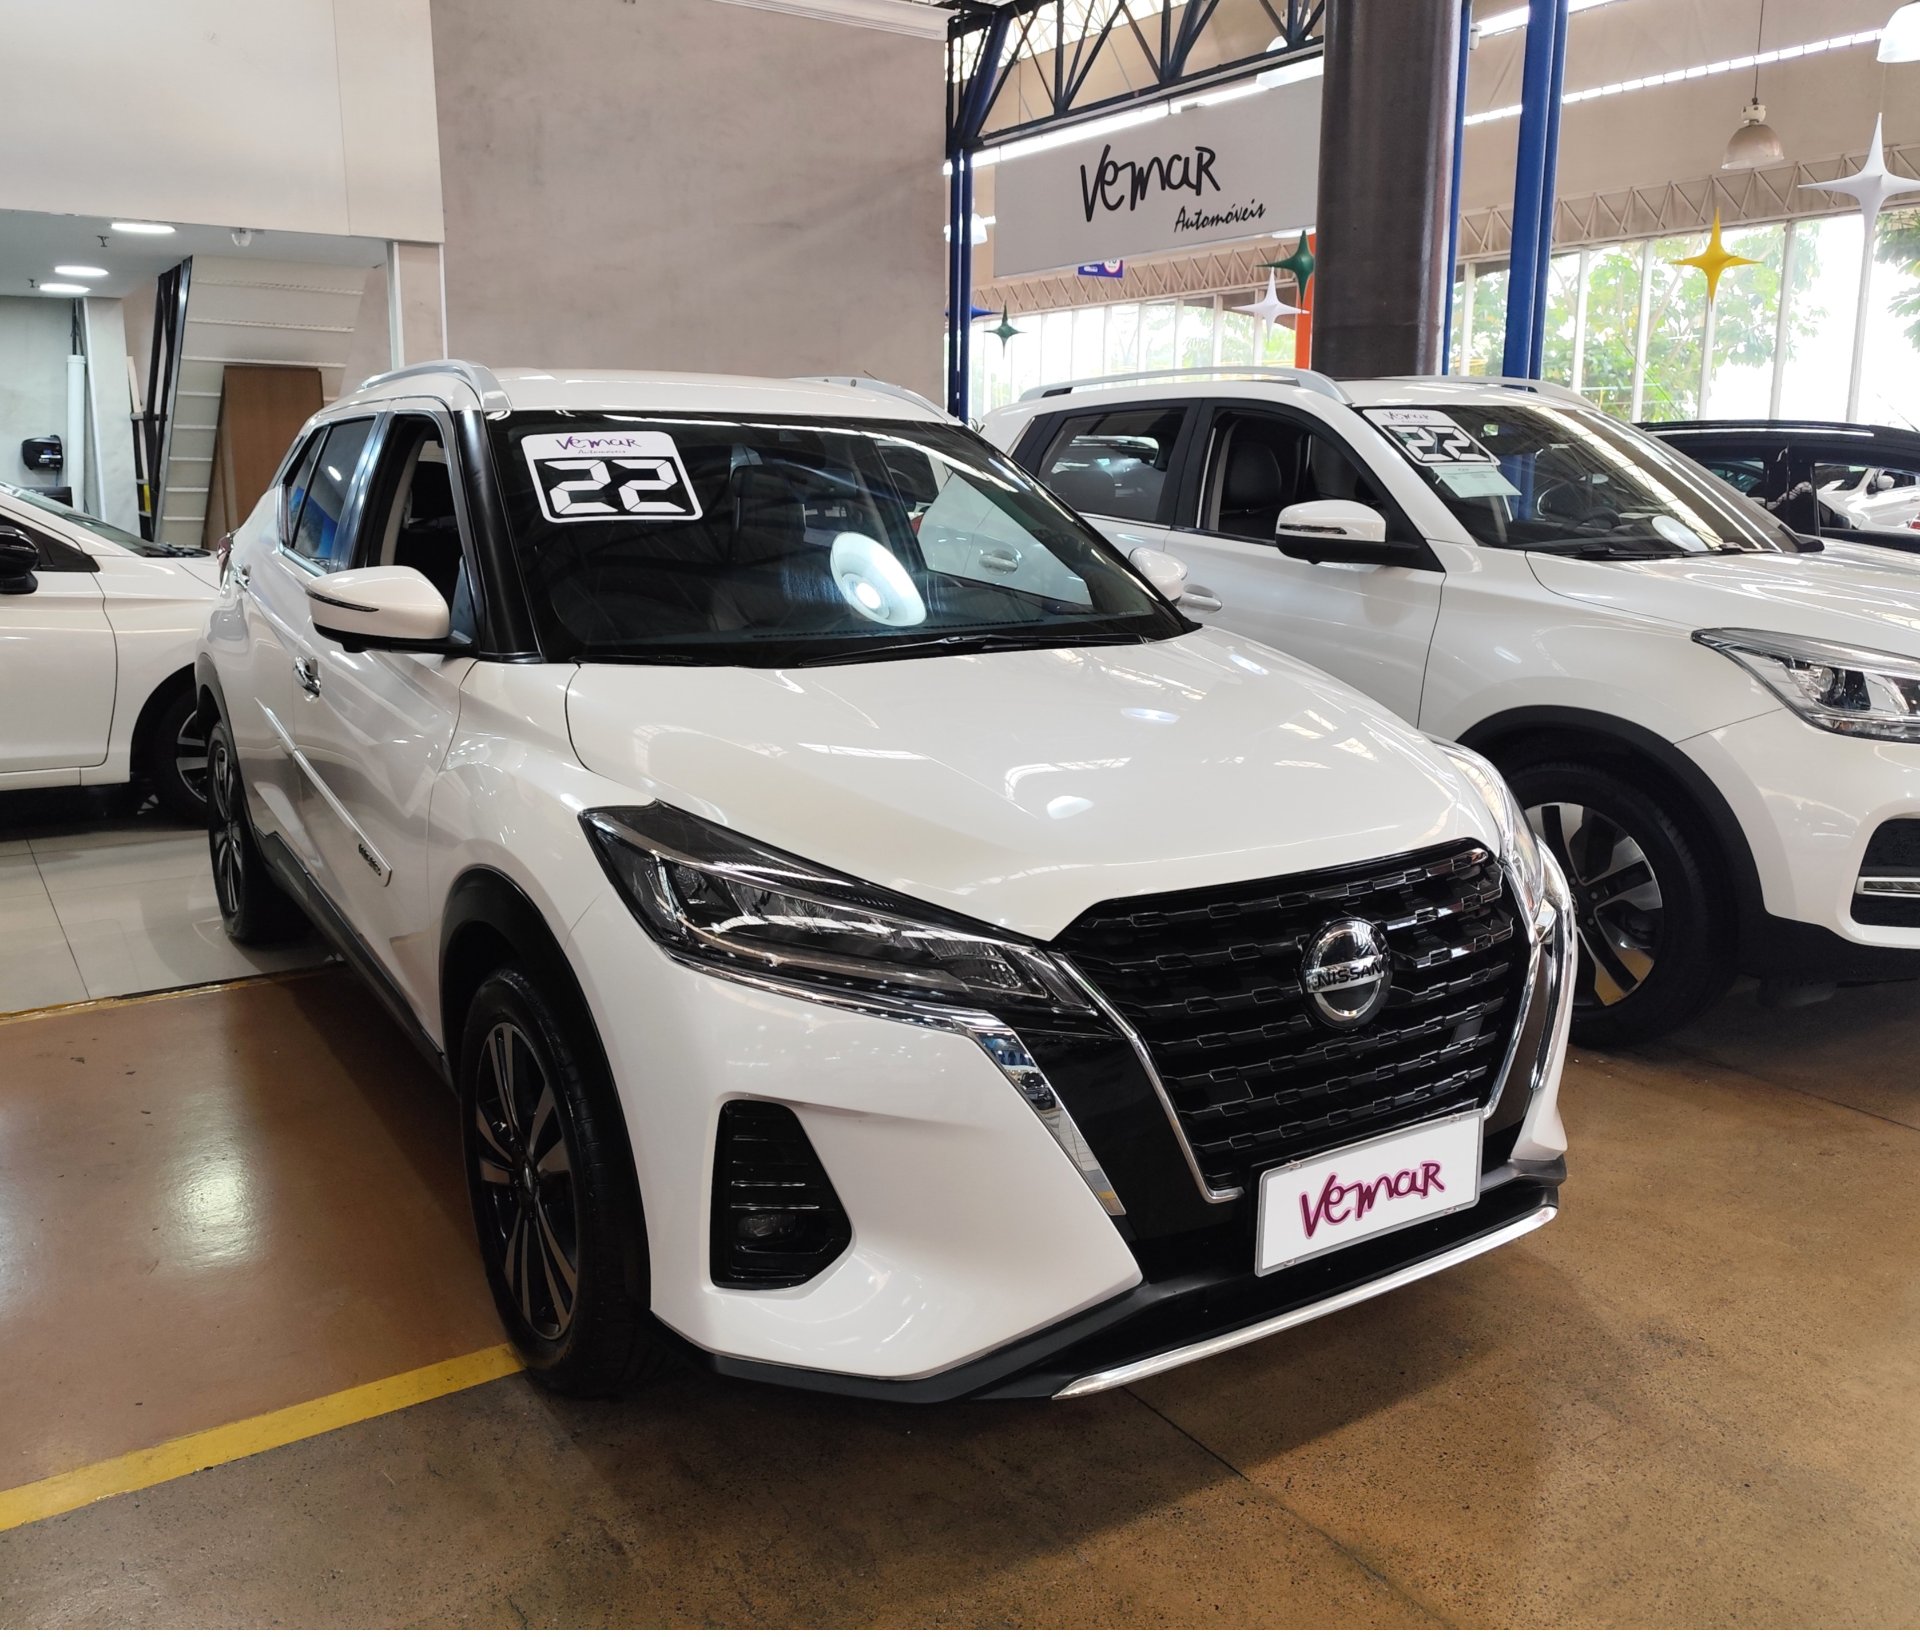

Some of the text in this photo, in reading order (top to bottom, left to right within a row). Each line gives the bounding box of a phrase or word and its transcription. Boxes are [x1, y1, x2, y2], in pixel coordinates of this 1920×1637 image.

[1173, 199, 1266, 233] Automóveis
[1388, 426, 1491, 461] 22
[544, 459, 687, 515] 22
[1316, 961, 1382, 987] NISSAN
